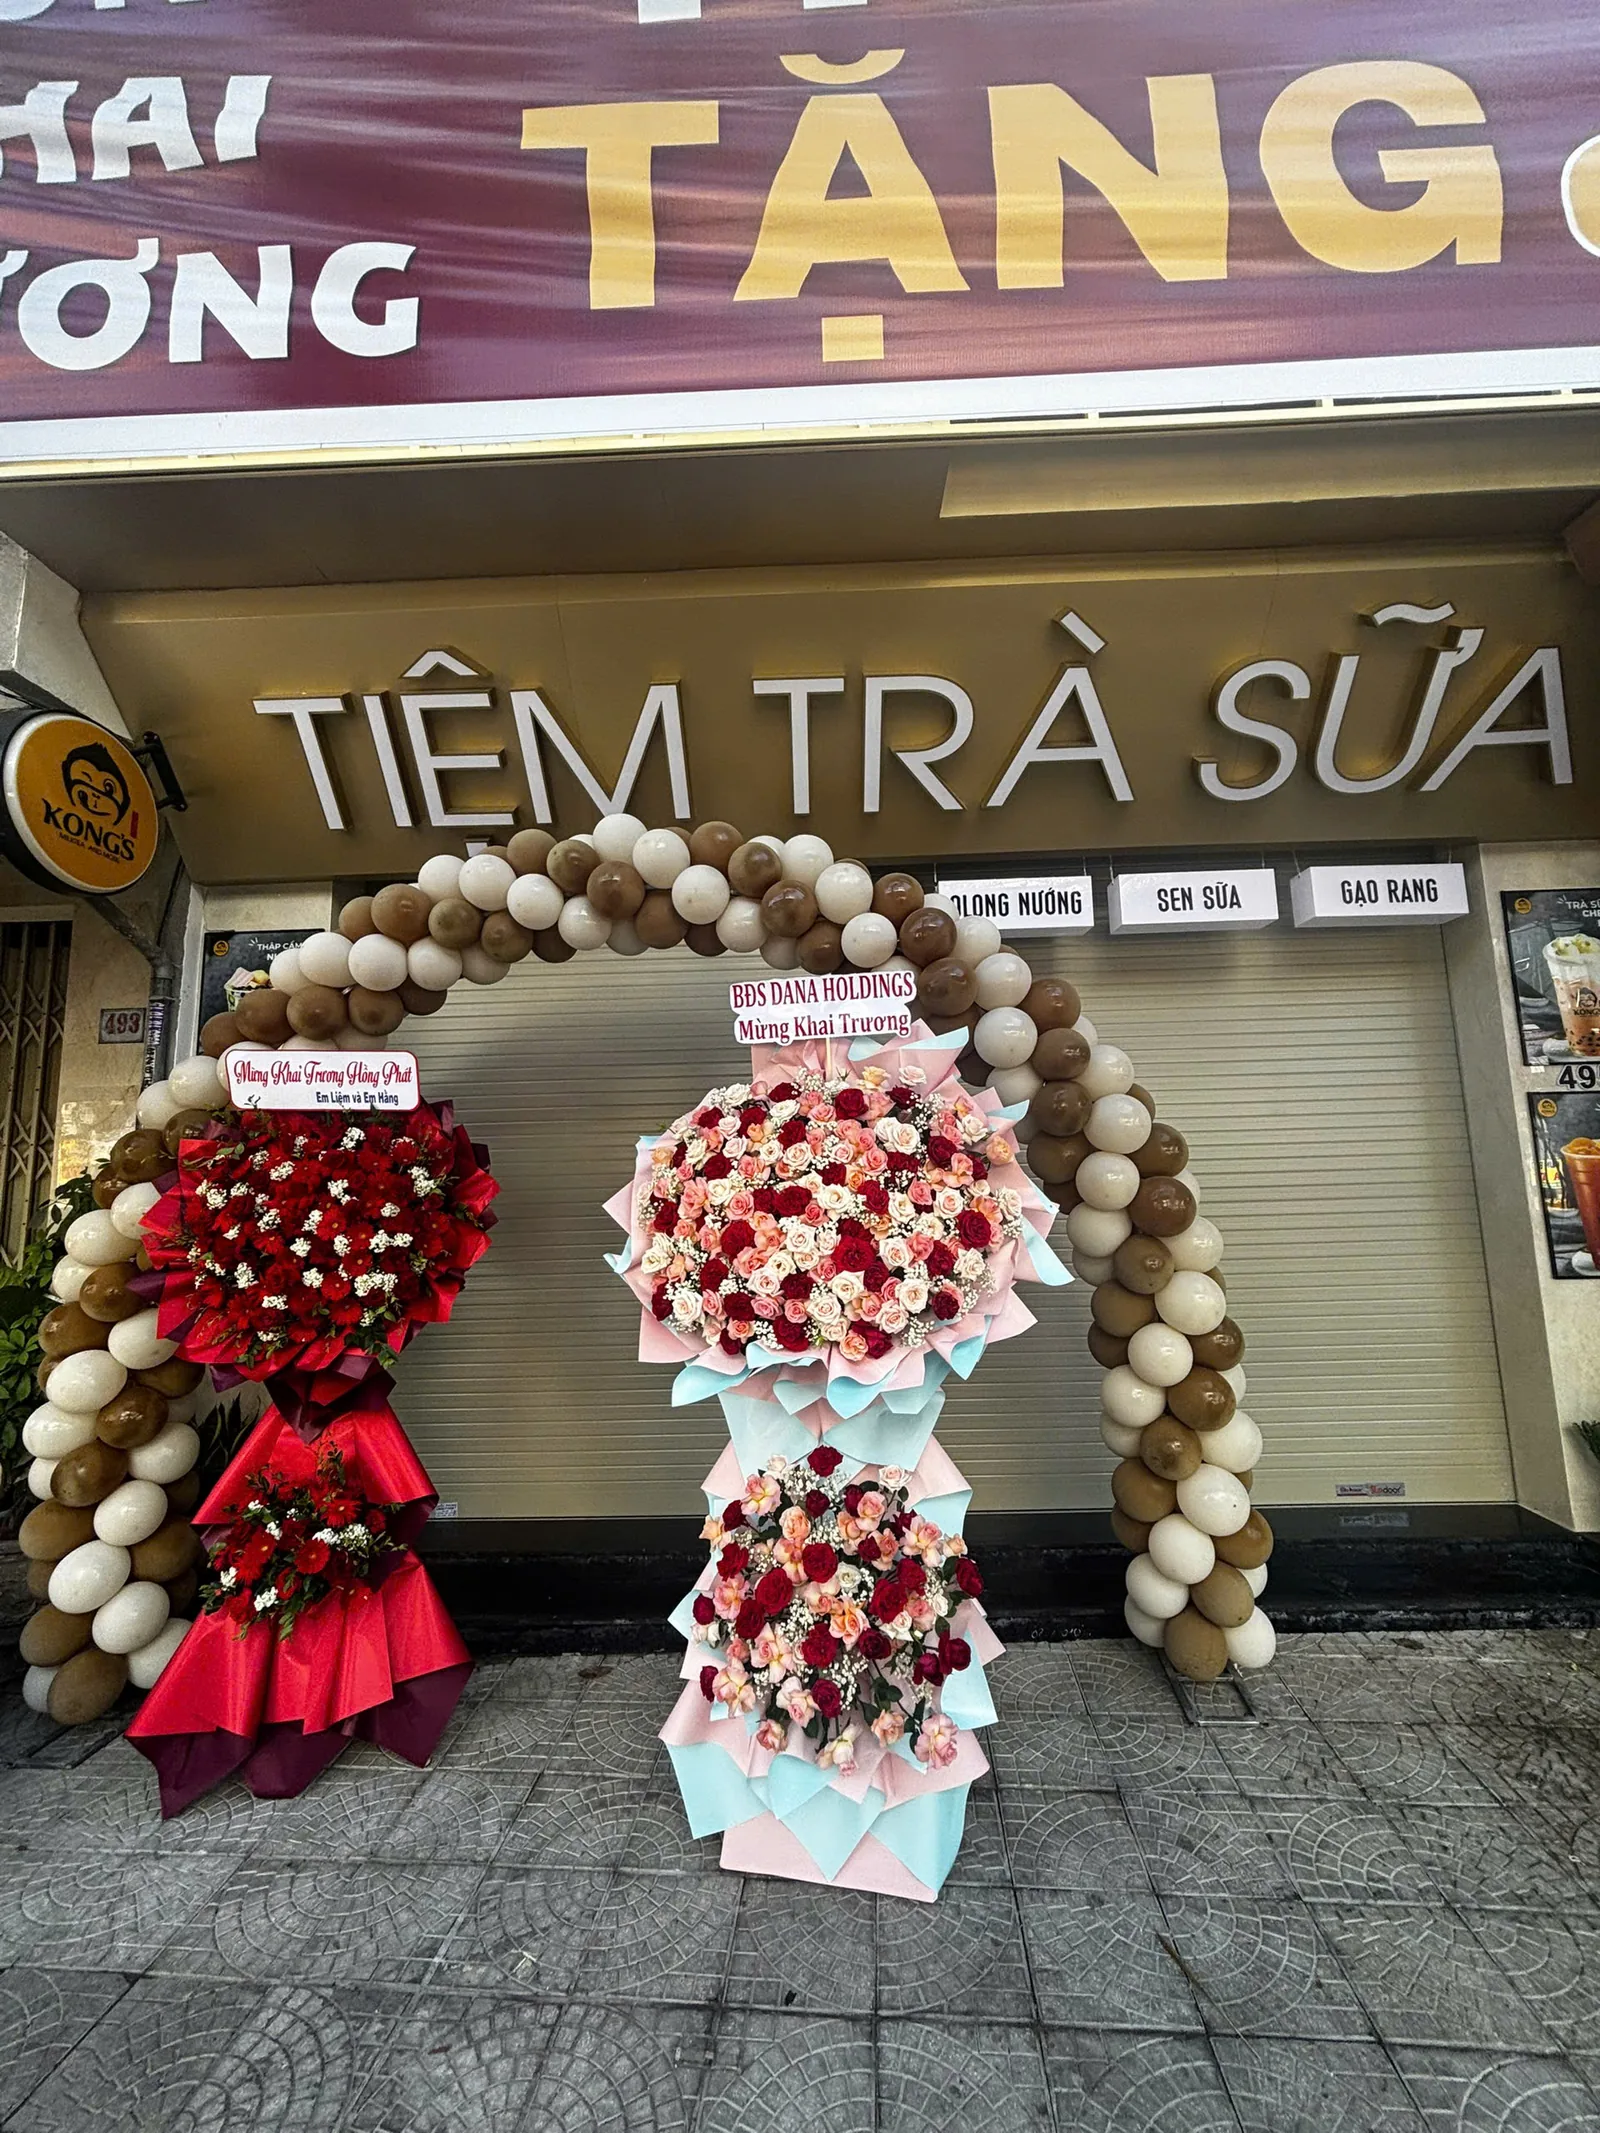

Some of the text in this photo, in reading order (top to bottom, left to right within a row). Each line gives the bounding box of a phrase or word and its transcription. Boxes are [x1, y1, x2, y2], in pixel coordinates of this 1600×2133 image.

[521, 48, 1503, 362] TẶNG
[252, 602, 1573, 857] TIỆM TRÀ SỮA
[42, 798, 135, 861] KONG'S
[1019, 886, 1082, 916] NƯỚNG
[1157, 881, 1242, 912] SEN SỮA
[1340, 878, 1439, 907] GẠO RANG
[1565, 899, 1589, 910] TRÀ
[732, 972, 914, 1009] BĐS DANA HOLDINGS
[105, 1012, 141, 1034] 493
[739, 1013, 909, 1044] Mừng Khai Trương
[234, 1060, 412, 1088] Mừng Khai Trương Hồng Phát
[316, 1091, 330, 1103] Em
[352, 1091, 362, 1103] và
[363, 1091, 377, 1103] Em
